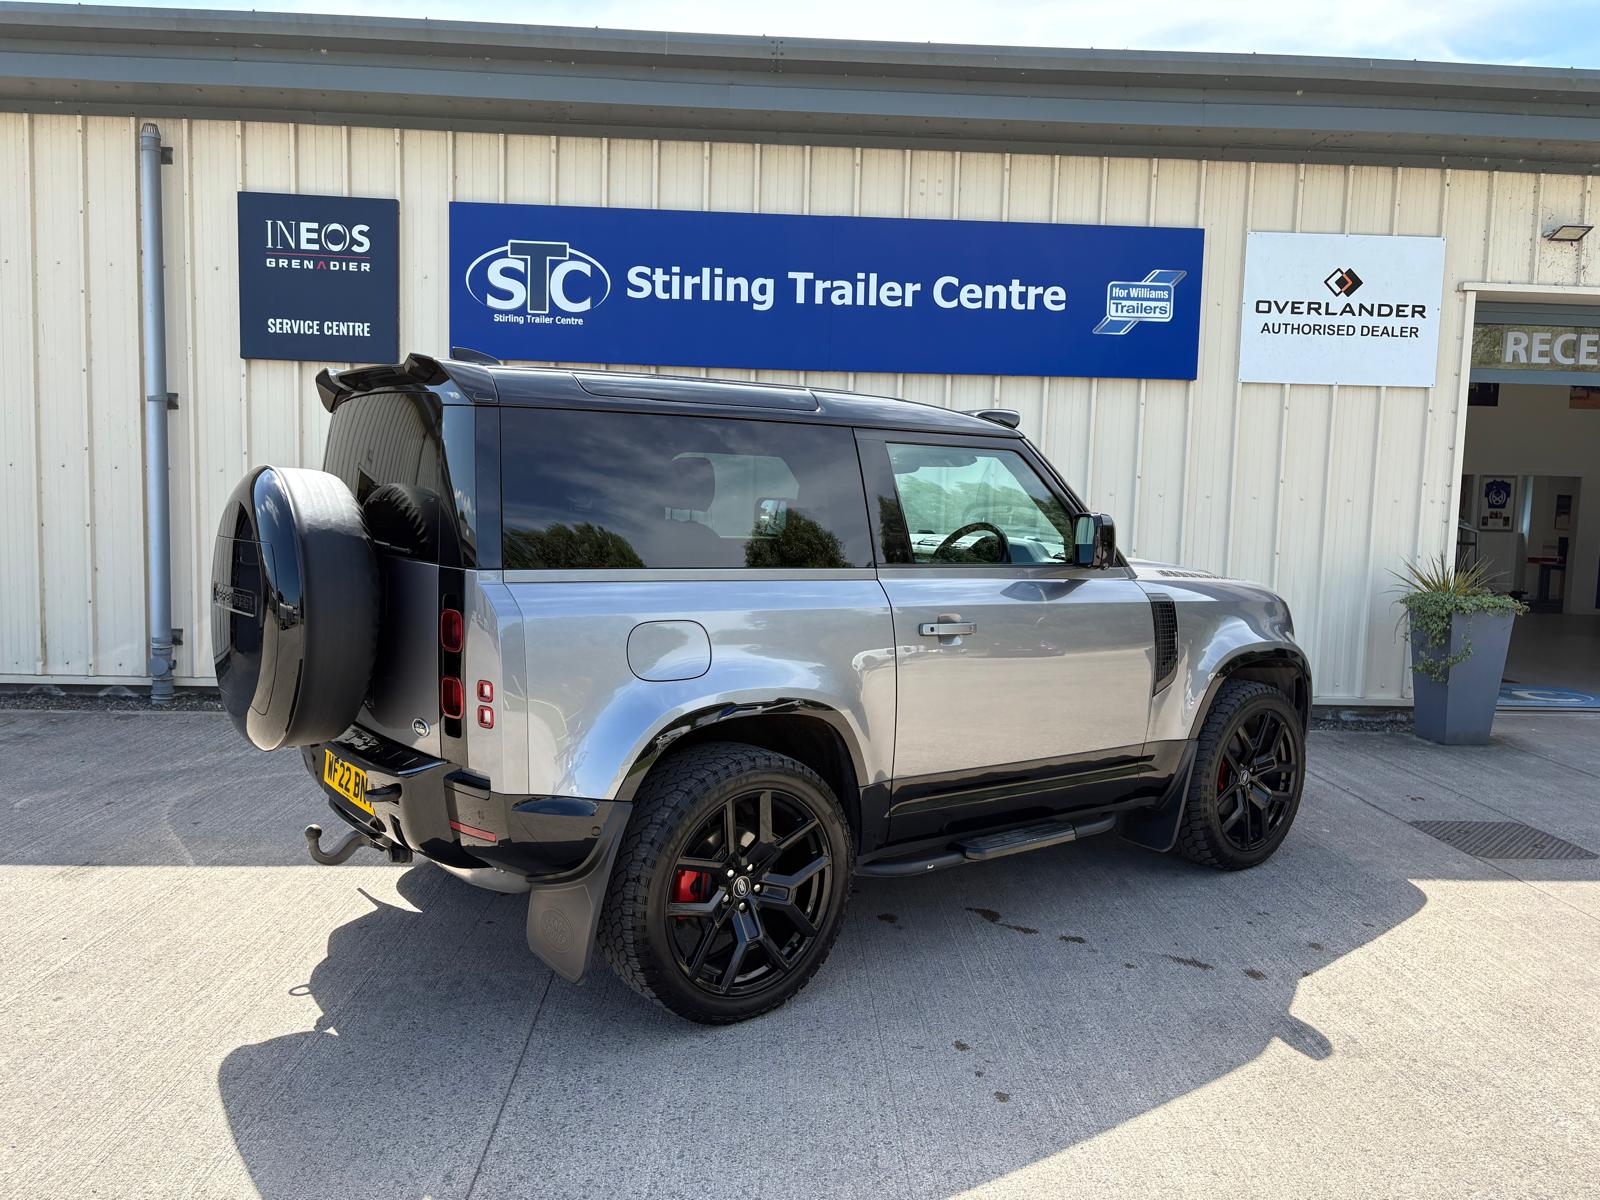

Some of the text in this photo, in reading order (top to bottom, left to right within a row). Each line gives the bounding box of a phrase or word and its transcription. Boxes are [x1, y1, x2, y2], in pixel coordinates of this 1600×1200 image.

[265, 219, 371, 253] INEOS
[266, 258, 371, 272] GRENADIER
[486, 239, 592, 314] STC
[626, 265, 1067, 311] Stirling Trailer Centre
[1112, 287, 1169, 299] Ifor Williams
[1112, 302, 1168, 315] Trailers
[1255, 299, 1427, 319] OVERLANDER
[267, 318, 371, 337] SERVICE CENTRE
[493, 313, 584, 326] Stirling Trailer Centre
[1260, 322, 1419, 338] AUTHORISED DEALER
[1505, 331, 1599, 365] RECE
